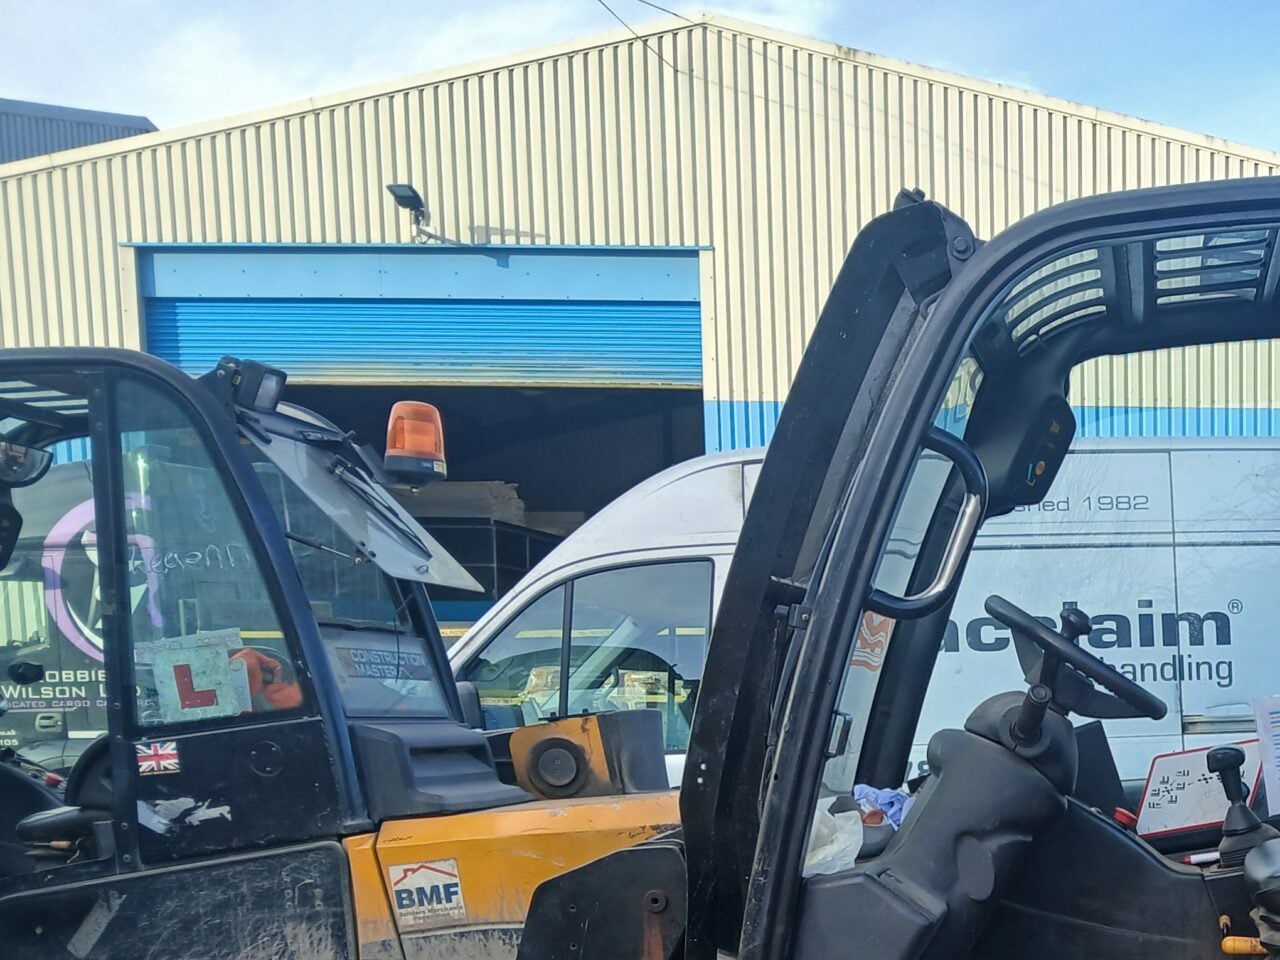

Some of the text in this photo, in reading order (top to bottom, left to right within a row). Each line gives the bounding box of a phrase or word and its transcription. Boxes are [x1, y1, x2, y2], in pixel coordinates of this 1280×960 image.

[1082, 495, 1151, 511] 1982
[938, 599, 1232, 653] caim
[39, 670, 106, 682] OBBIE
[172, 662, 219, 710] L
[1, 684, 86, 698] WILSON
[394, 882, 459, 910] BMF
